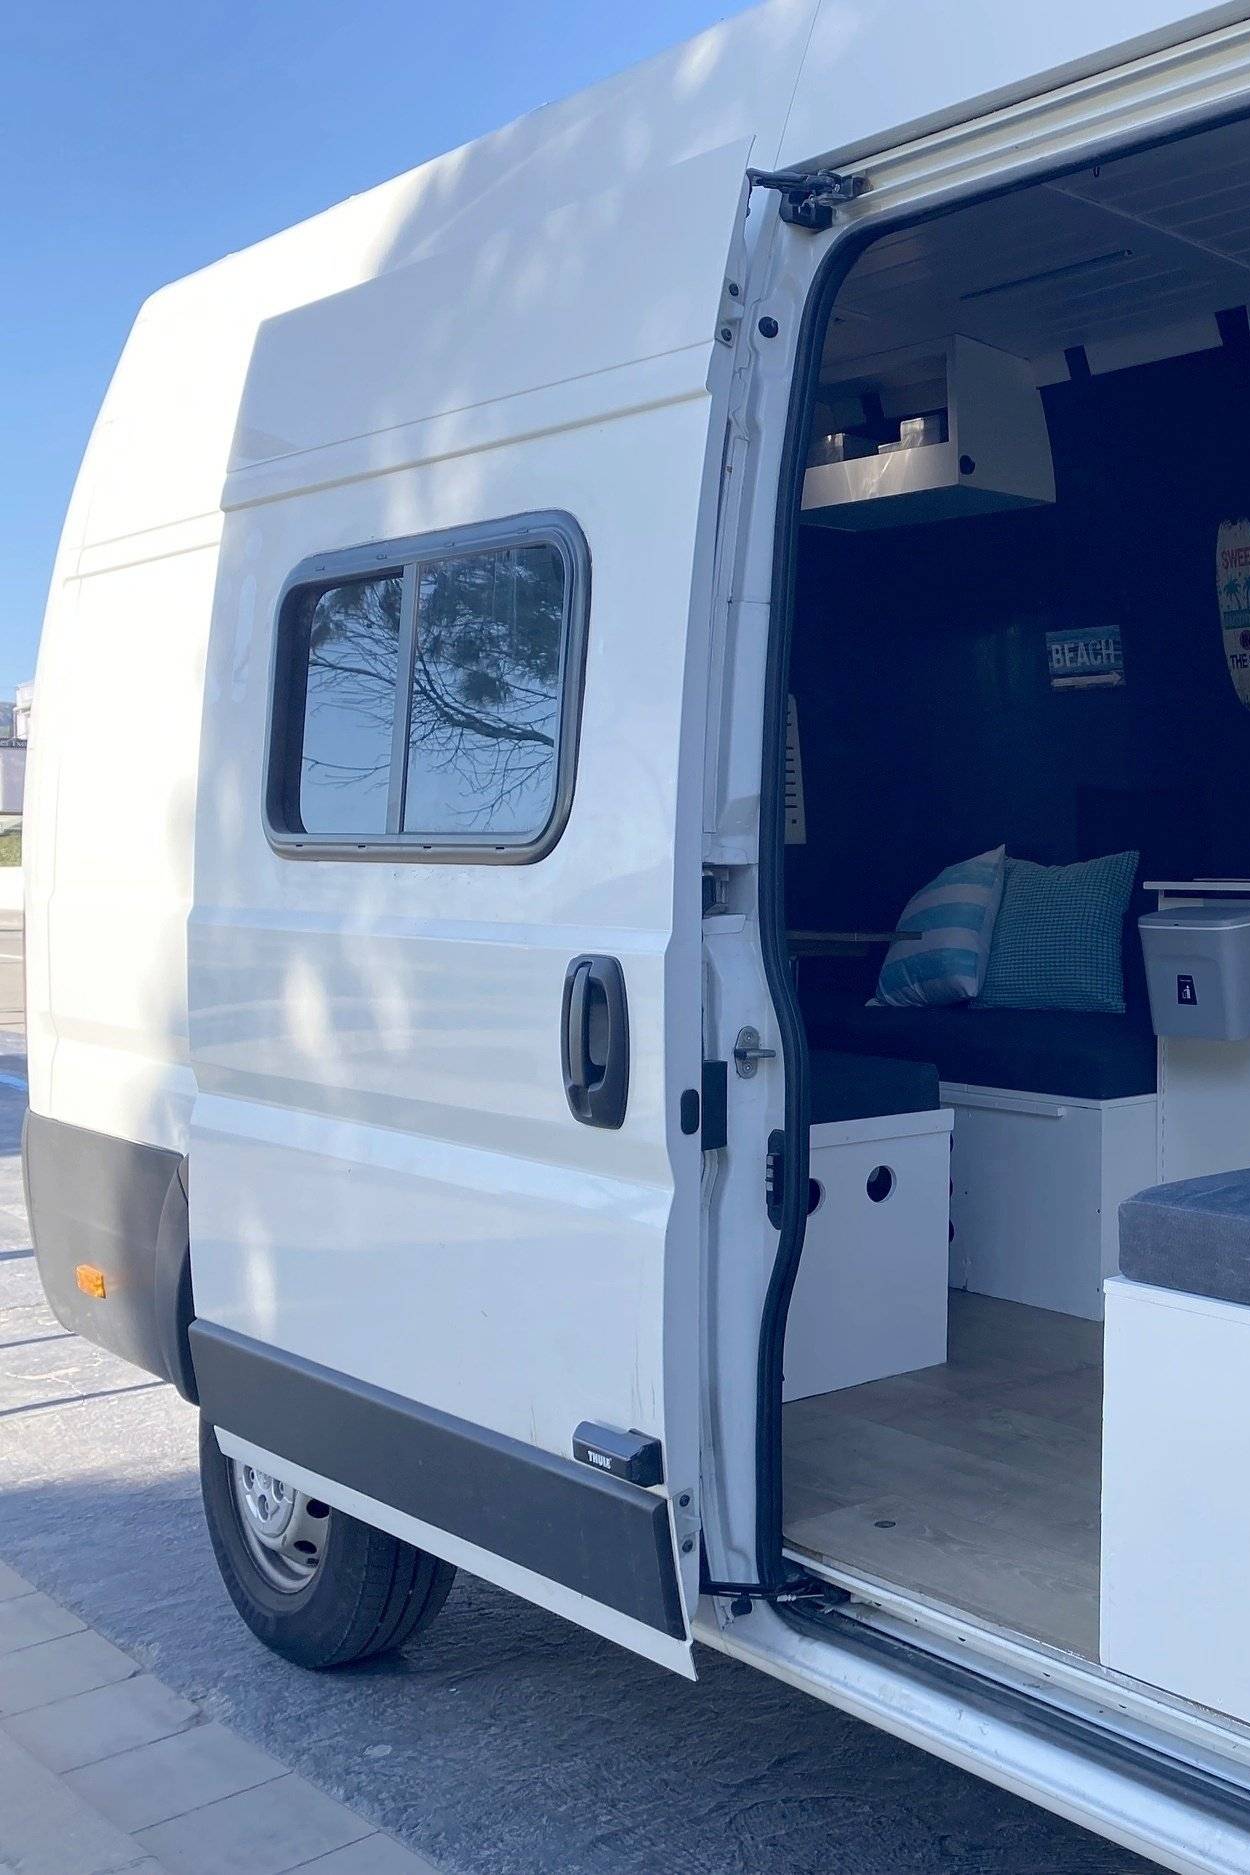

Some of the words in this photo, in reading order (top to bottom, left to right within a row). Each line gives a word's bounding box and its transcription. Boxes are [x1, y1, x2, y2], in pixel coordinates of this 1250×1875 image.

[1051, 639, 1115, 668] BEACH
[1229, 654, 1249, 670] THE
[587, 1450, 611, 1470] THULE
